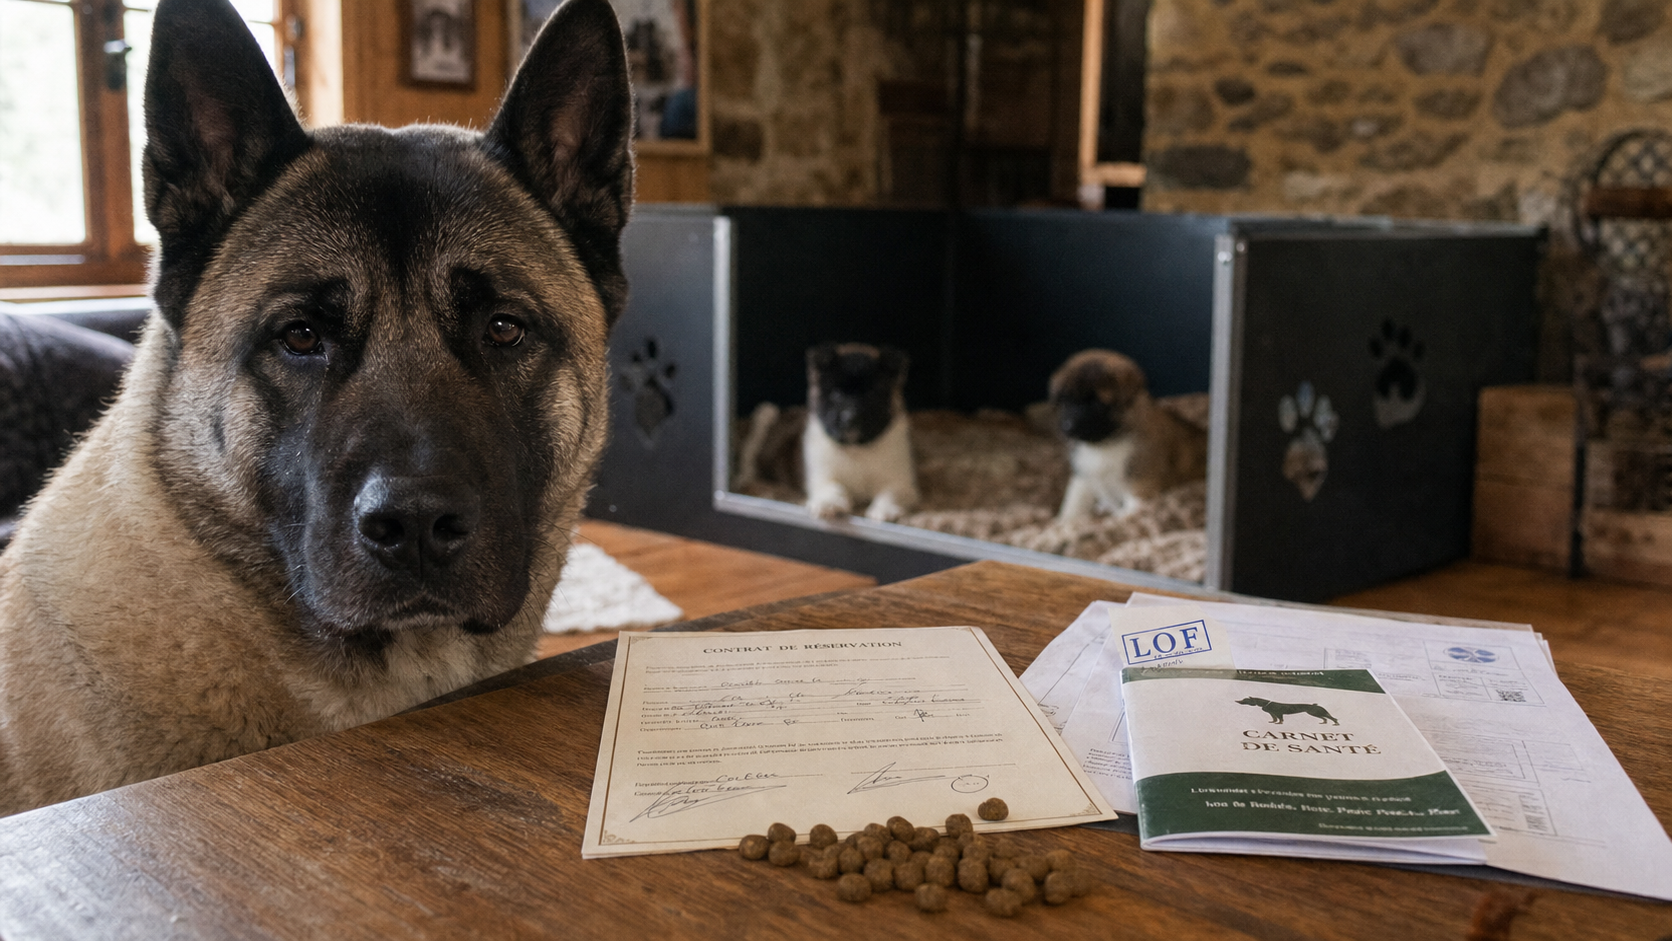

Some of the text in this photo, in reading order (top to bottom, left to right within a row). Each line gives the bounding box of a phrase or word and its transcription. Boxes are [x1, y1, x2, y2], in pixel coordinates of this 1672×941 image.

[703, 645, 772, 654] CONTRAT
[804, 641, 902, 651] RÉSERVATION
[1129, 626, 1199, 658] LOF
[1243, 729, 1354, 742] CARNET
[1241, 742, 1382, 755] DE SANTÉ
